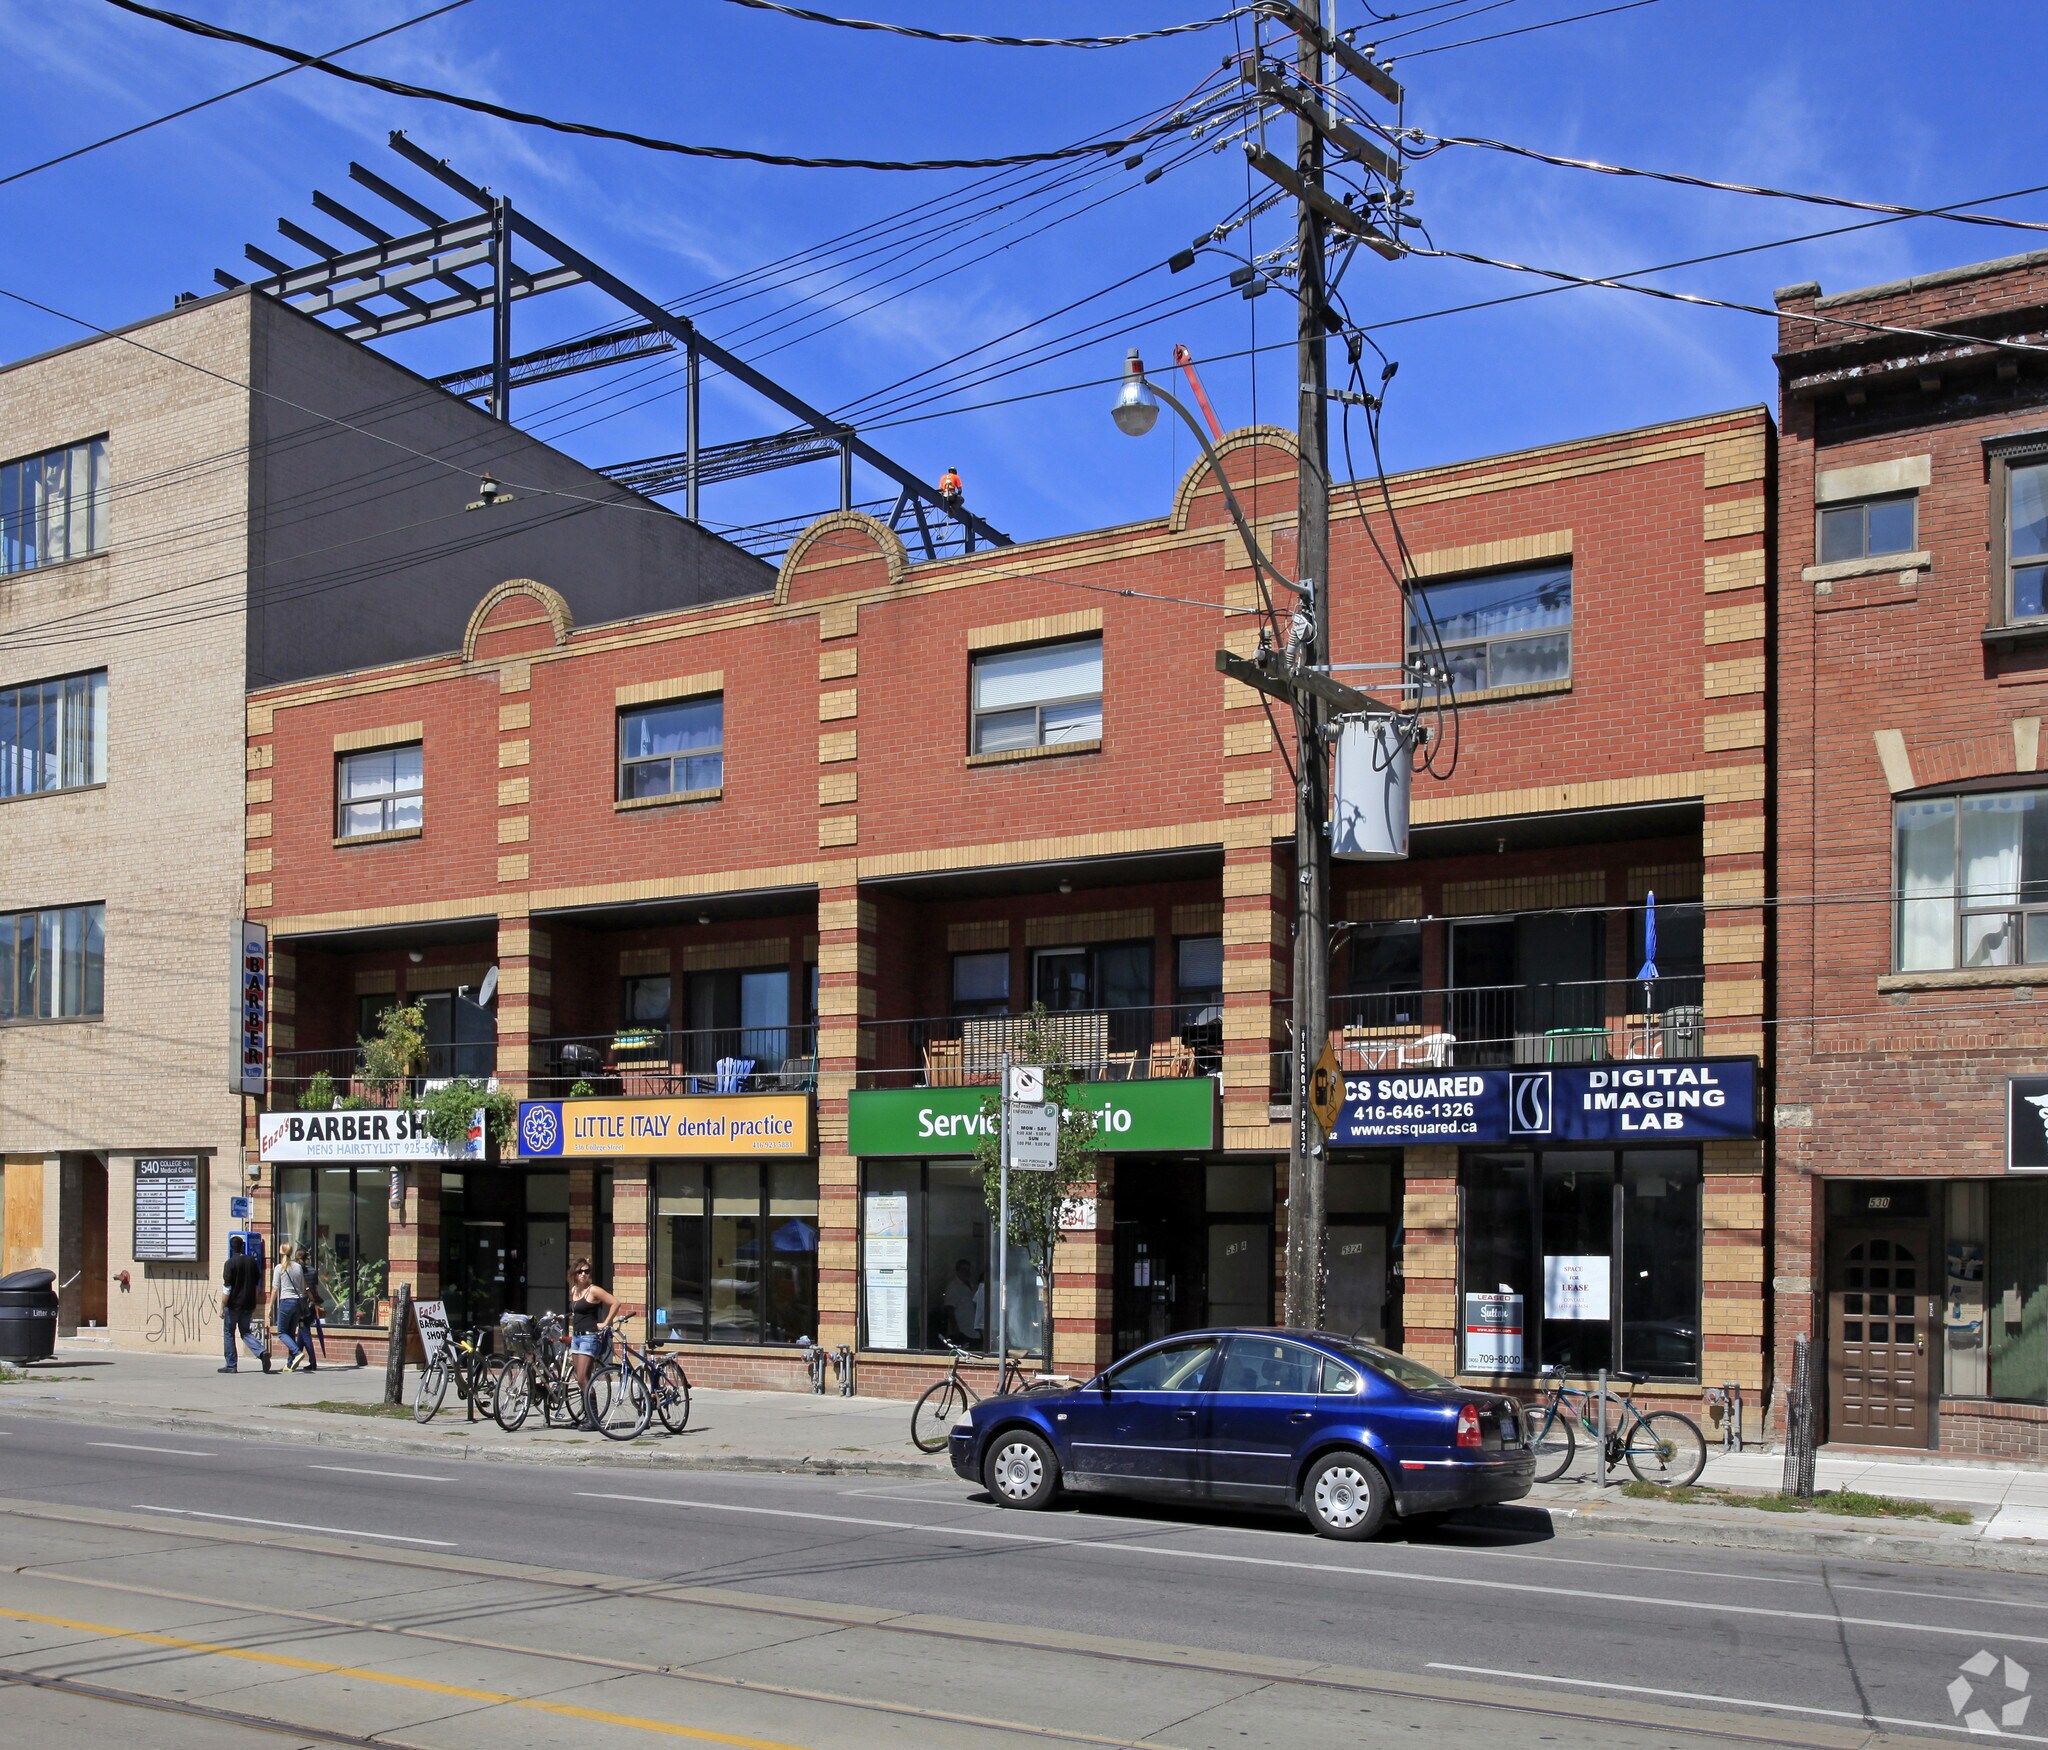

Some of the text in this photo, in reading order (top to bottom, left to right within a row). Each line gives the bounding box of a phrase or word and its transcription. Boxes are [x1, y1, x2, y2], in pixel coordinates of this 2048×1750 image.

[249, 957, 261, 1065] BARBER
[1589, 1067, 1719, 1088] DIGITAL
[1345, 1076, 1485, 1101] CS SQUARED
[1583, 1089, 1726, 1110] IMAGING
[1354, 1102, 1474, 1121] 416-646-1326
[574, 1113, 794, 1142] LITTLE ITALY dental practice
[1351, 1120, 1478, 1138] www.cssquared.ca
[1621, 1112, 1684, 1131] LAB
[262, 1117, 290, 1154] Enzo's
[289, 1115, 391, 1142] BARBER
[307, 1143, 334, 1155] MENS
[336, 1142, 401, 1155] HAIRSTYLIST
[585, 1143, 606, 1151] College
[607, 1142, 625, 1151] Street
[141, 1160, 160, 1174] 540
[160, 1160, 182, 1168] COLLEGE
[178, 1166, 194, 1174] Centre
[1870, 1198, 1889, 1208] 530
[33, 1309, 48, 1317] Litter
[1480, 1305, 1509, 1319] Sutton
[1479, 1353, 1521, 1365] 709-8000
